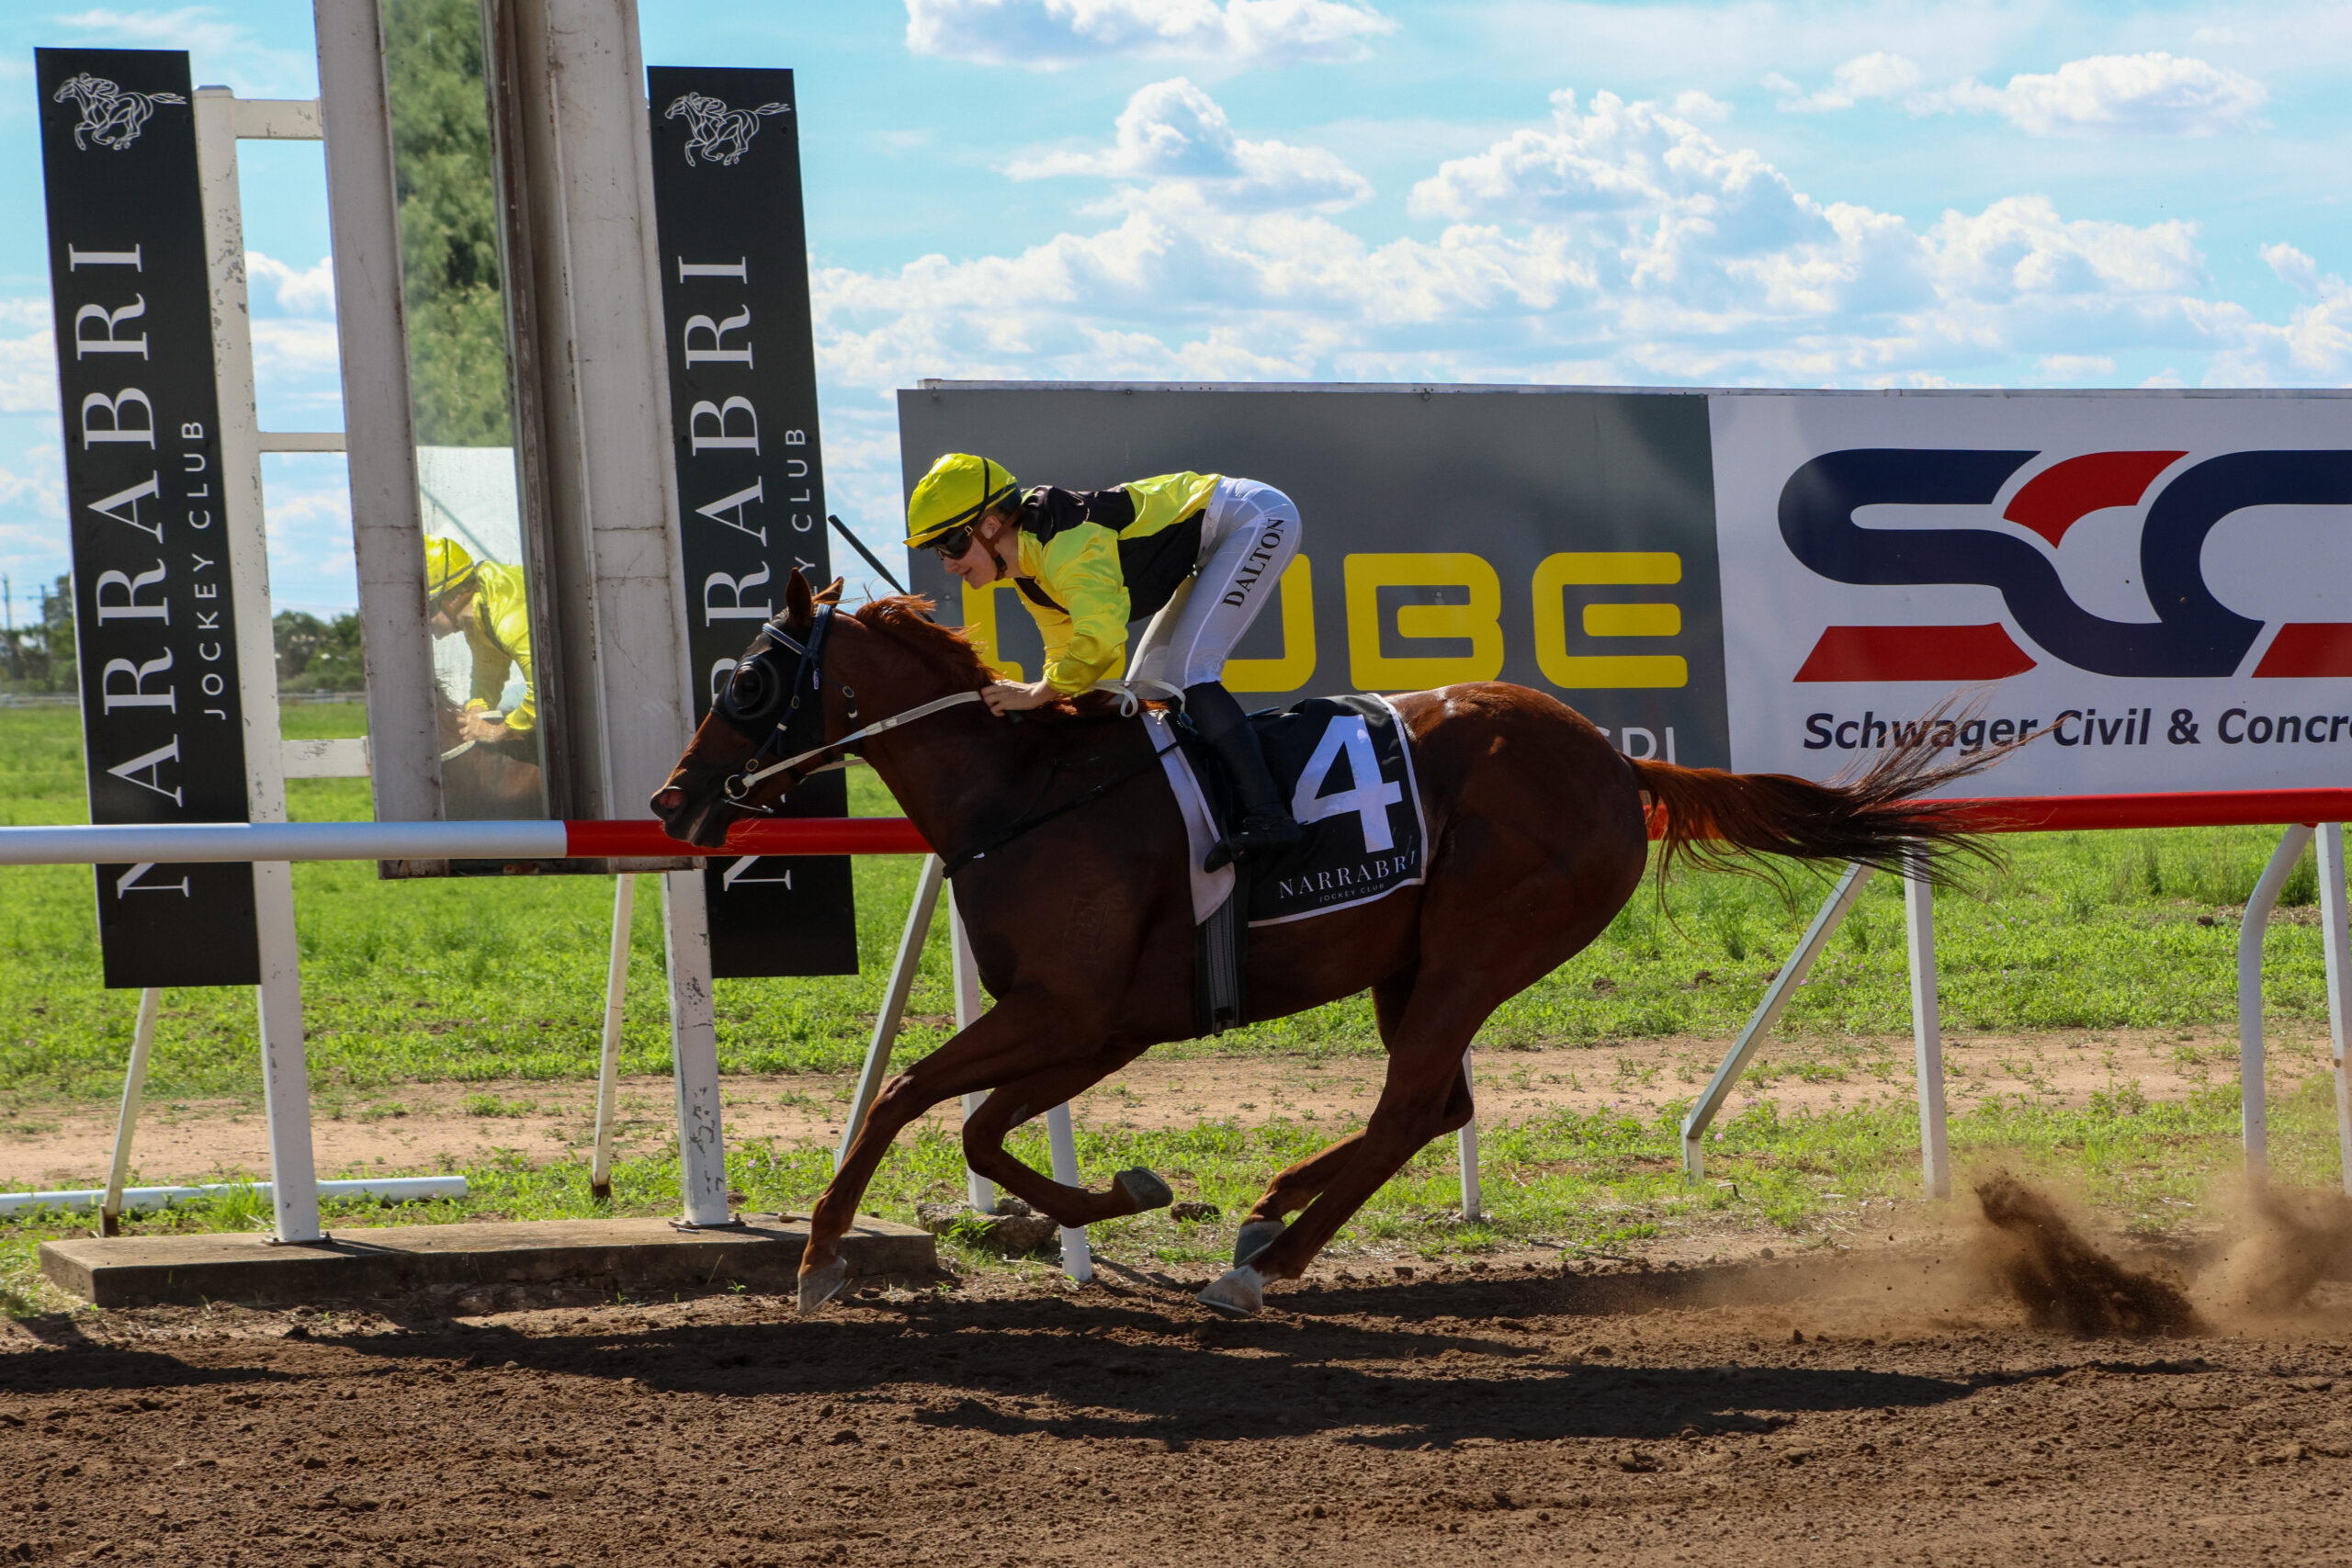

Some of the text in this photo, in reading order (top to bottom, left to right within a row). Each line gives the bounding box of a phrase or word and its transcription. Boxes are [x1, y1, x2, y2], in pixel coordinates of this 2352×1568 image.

[786, 428, 812, 532] CLUB
[181, 422, 226, 720] JOCKEY CLUB
[678, 256, 792, 892] RABRI
[1221, 518, 1284, 608] DALTON
[1804, 708, 2352, 756] Schwager Civil & Concr
[1292, 714, 1402, 853] 4
[1279, 850, 1416, 898] NARRABRI
[1319, 883, 1385, 903] JOCKEY CLUB
